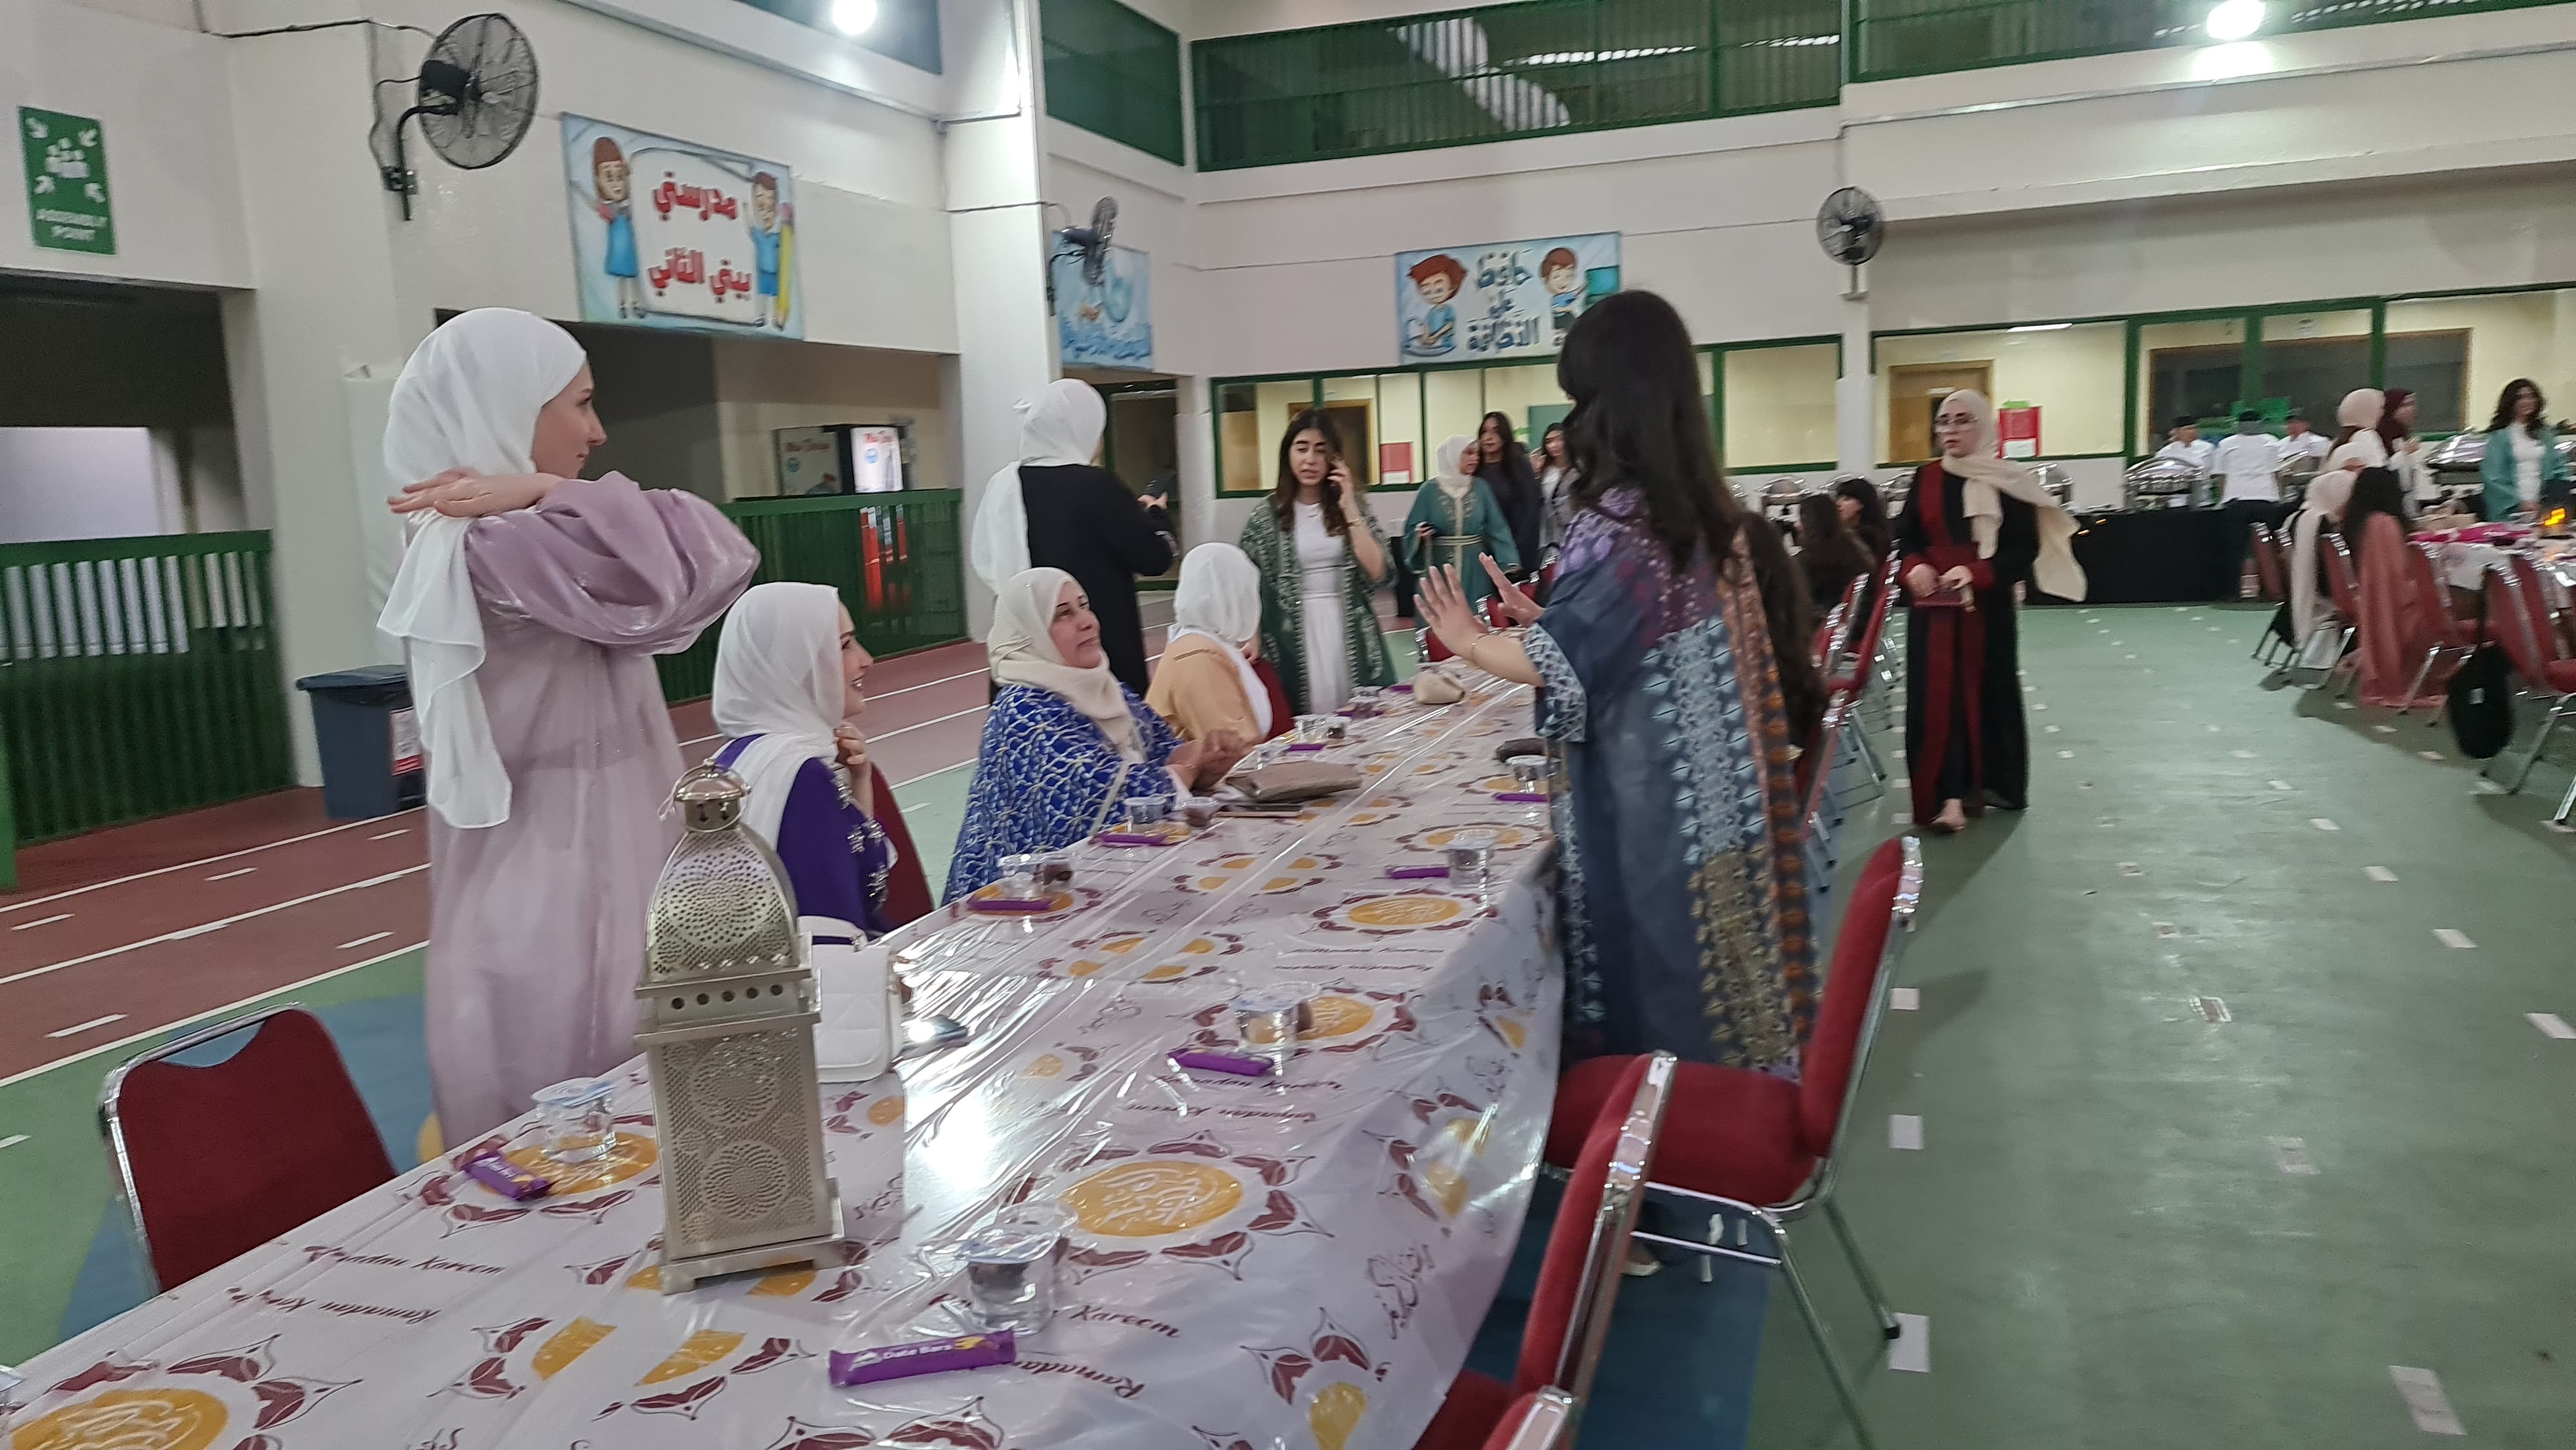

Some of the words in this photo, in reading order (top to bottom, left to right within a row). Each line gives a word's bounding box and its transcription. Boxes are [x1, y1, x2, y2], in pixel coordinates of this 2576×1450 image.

[653, 170, 737, 221] مدرستي
[318, 1301, 442, 1325] Ramadan
[1070, 1305, 1181, 1339] Kareem
